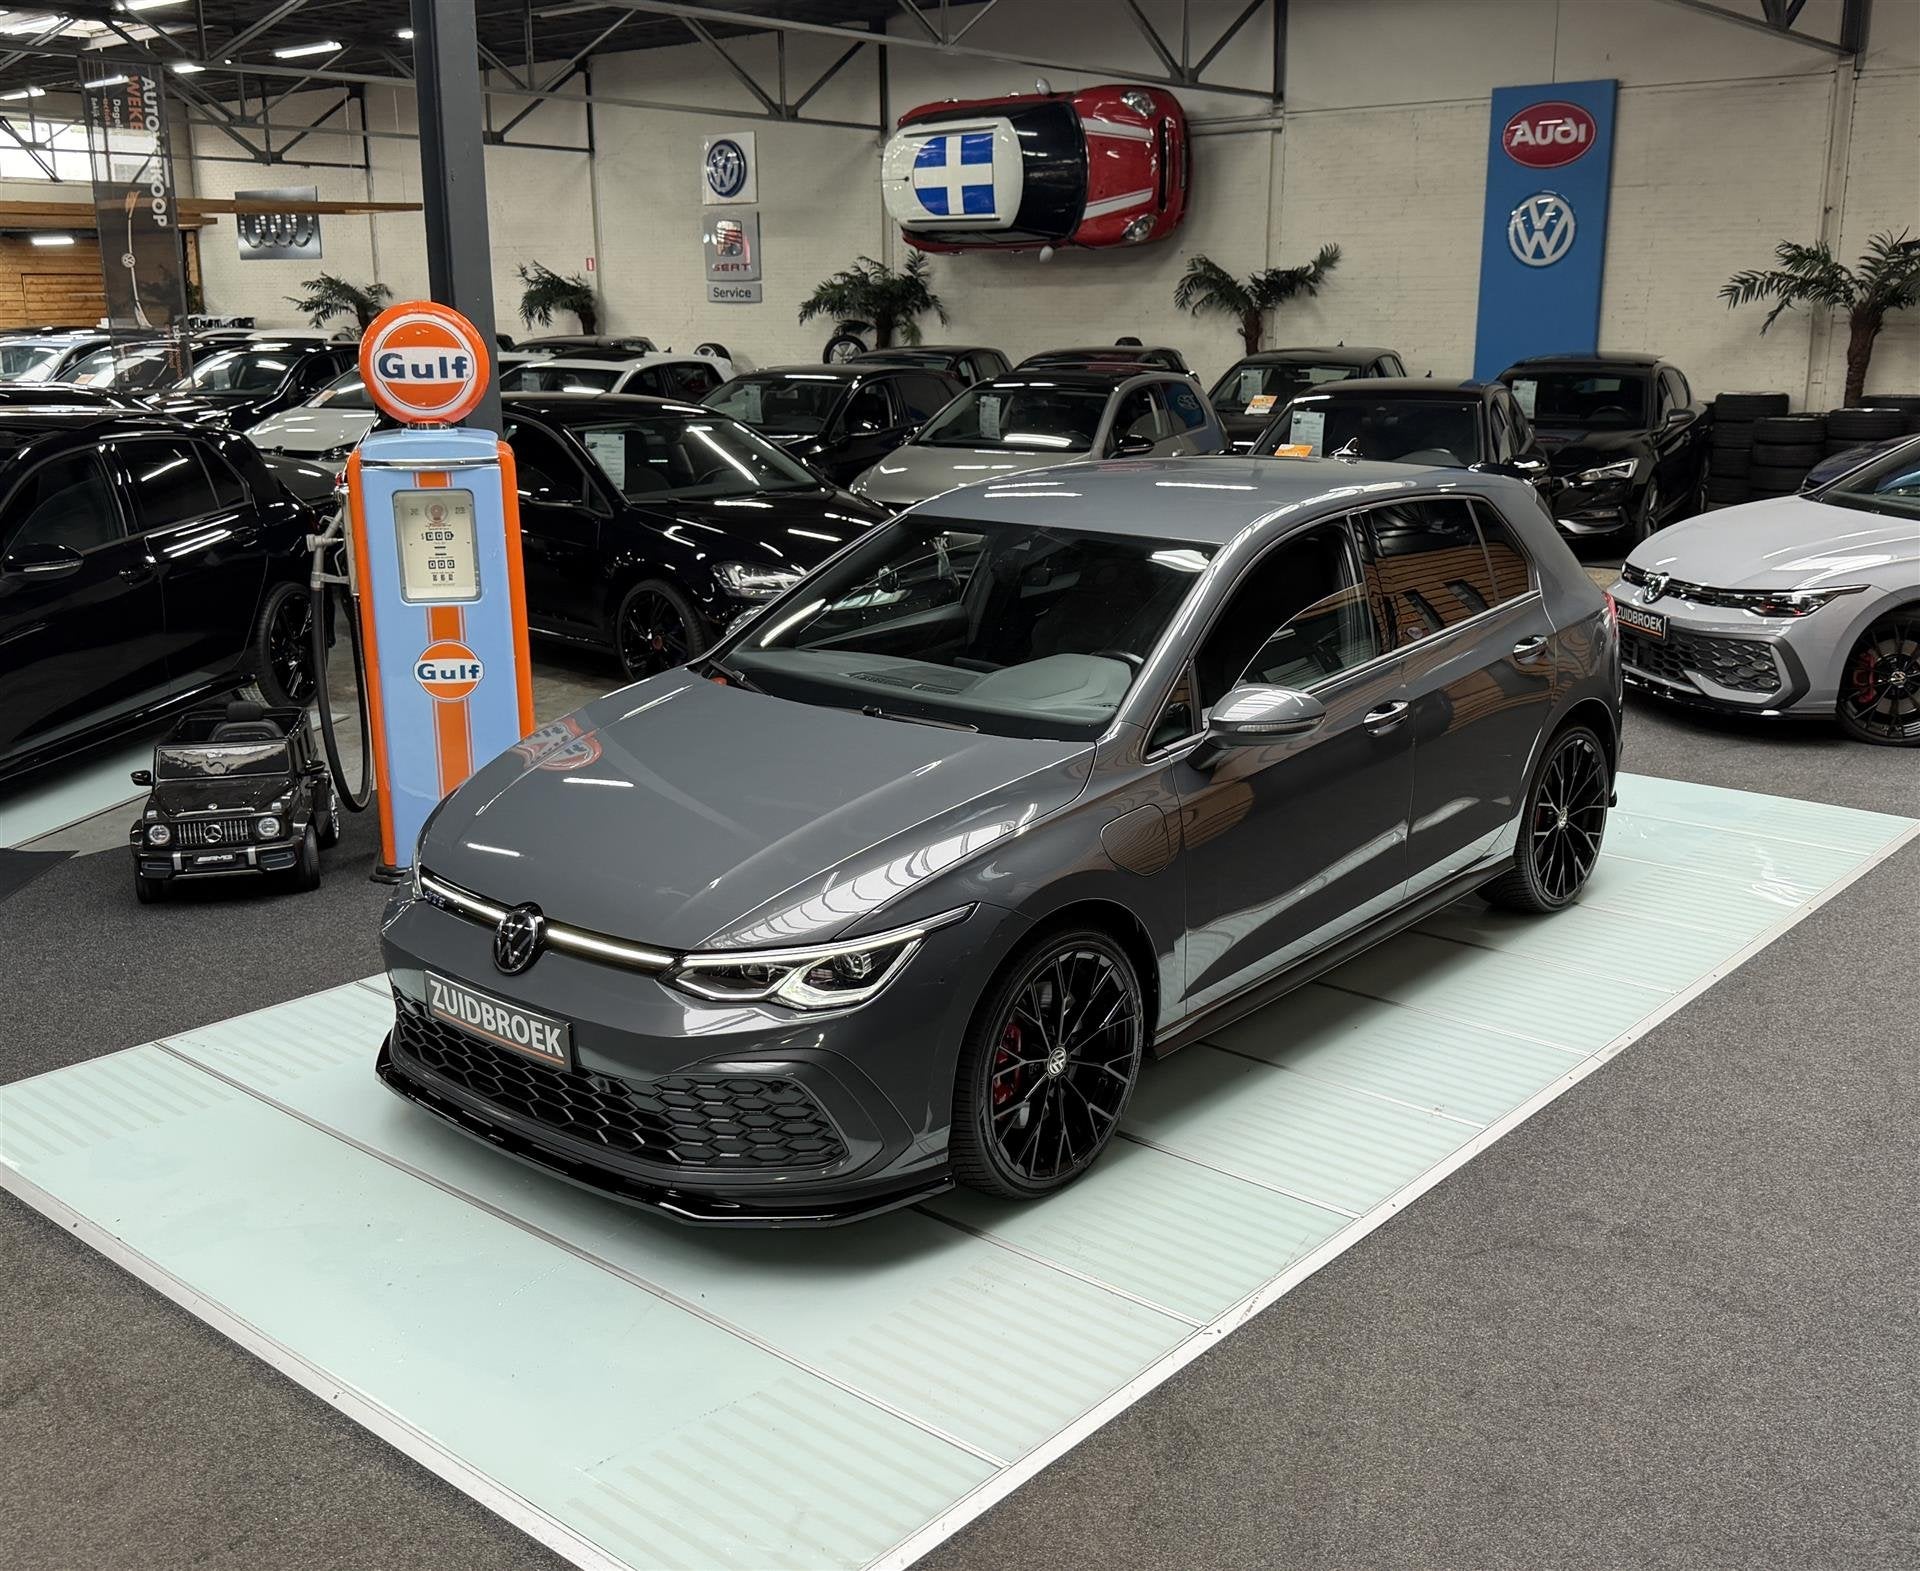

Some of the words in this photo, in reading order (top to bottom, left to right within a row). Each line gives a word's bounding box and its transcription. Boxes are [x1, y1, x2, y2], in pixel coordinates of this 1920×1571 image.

[127, 75, 143, 130] WEKE
[713, 287, 752, 298] Service
[378, 352, 468, 380] Gulf
[1616, 605, 1663, 632] ZUIDBROEK
[417, 663, 480, 680] Gulf
[430, 980, 564, 1058] ZUIDBROEK
